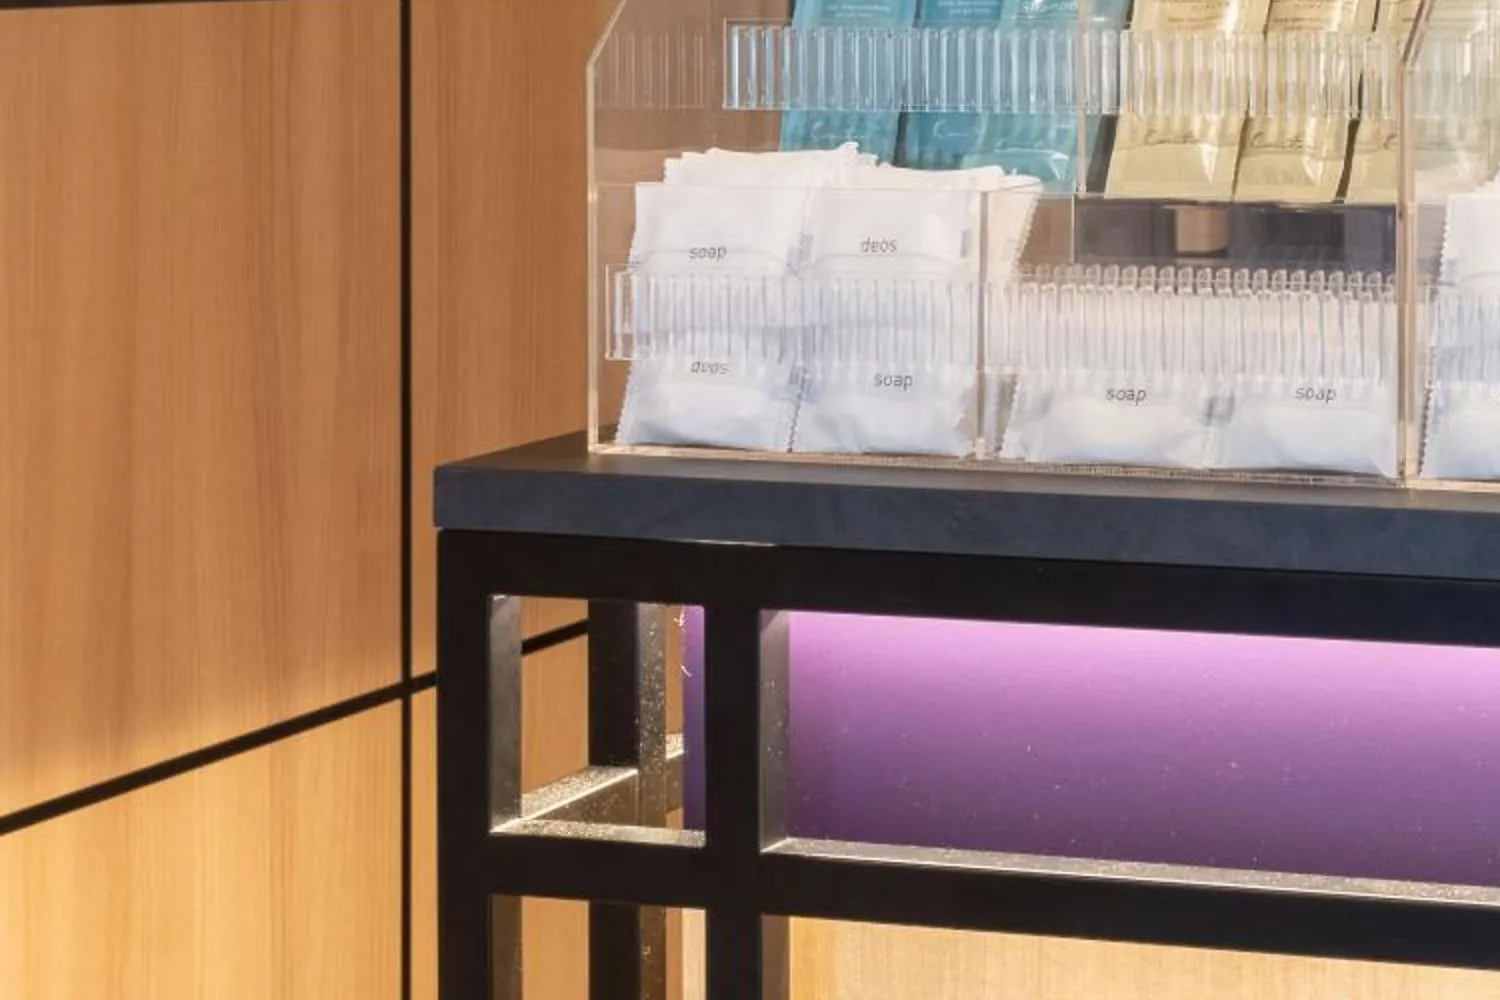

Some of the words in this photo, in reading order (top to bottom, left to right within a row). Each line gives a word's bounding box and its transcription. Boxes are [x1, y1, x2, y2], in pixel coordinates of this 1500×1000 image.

[688, 246, 727, 260] soap
[874, 372, 913, 390] soap
[1106, 388, 1147, 406] soap
[1295, 385, 1337, 403] soap
